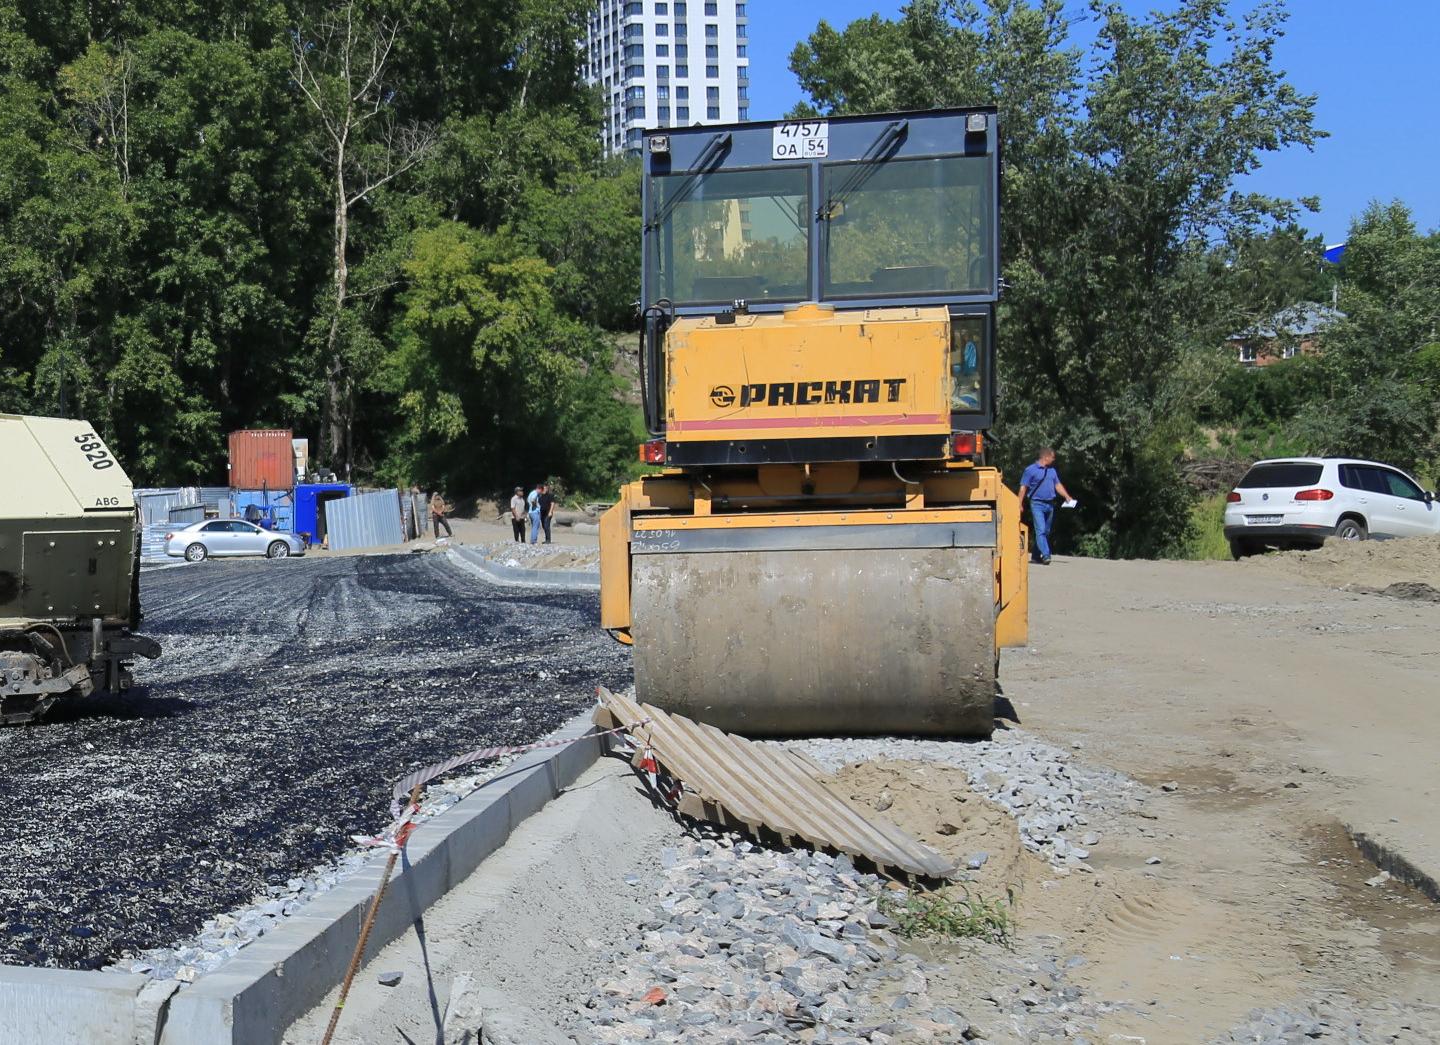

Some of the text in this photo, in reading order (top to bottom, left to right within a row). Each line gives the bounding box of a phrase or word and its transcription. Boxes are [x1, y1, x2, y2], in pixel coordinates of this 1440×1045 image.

[780, 121, 822, 138] 4757
[807, 139, 824, 151] 54
[739, 378, 907, 408] РАСКАТ
[74, 432, 114, 471] 5820
[95, 497, 119, 506] ABG
